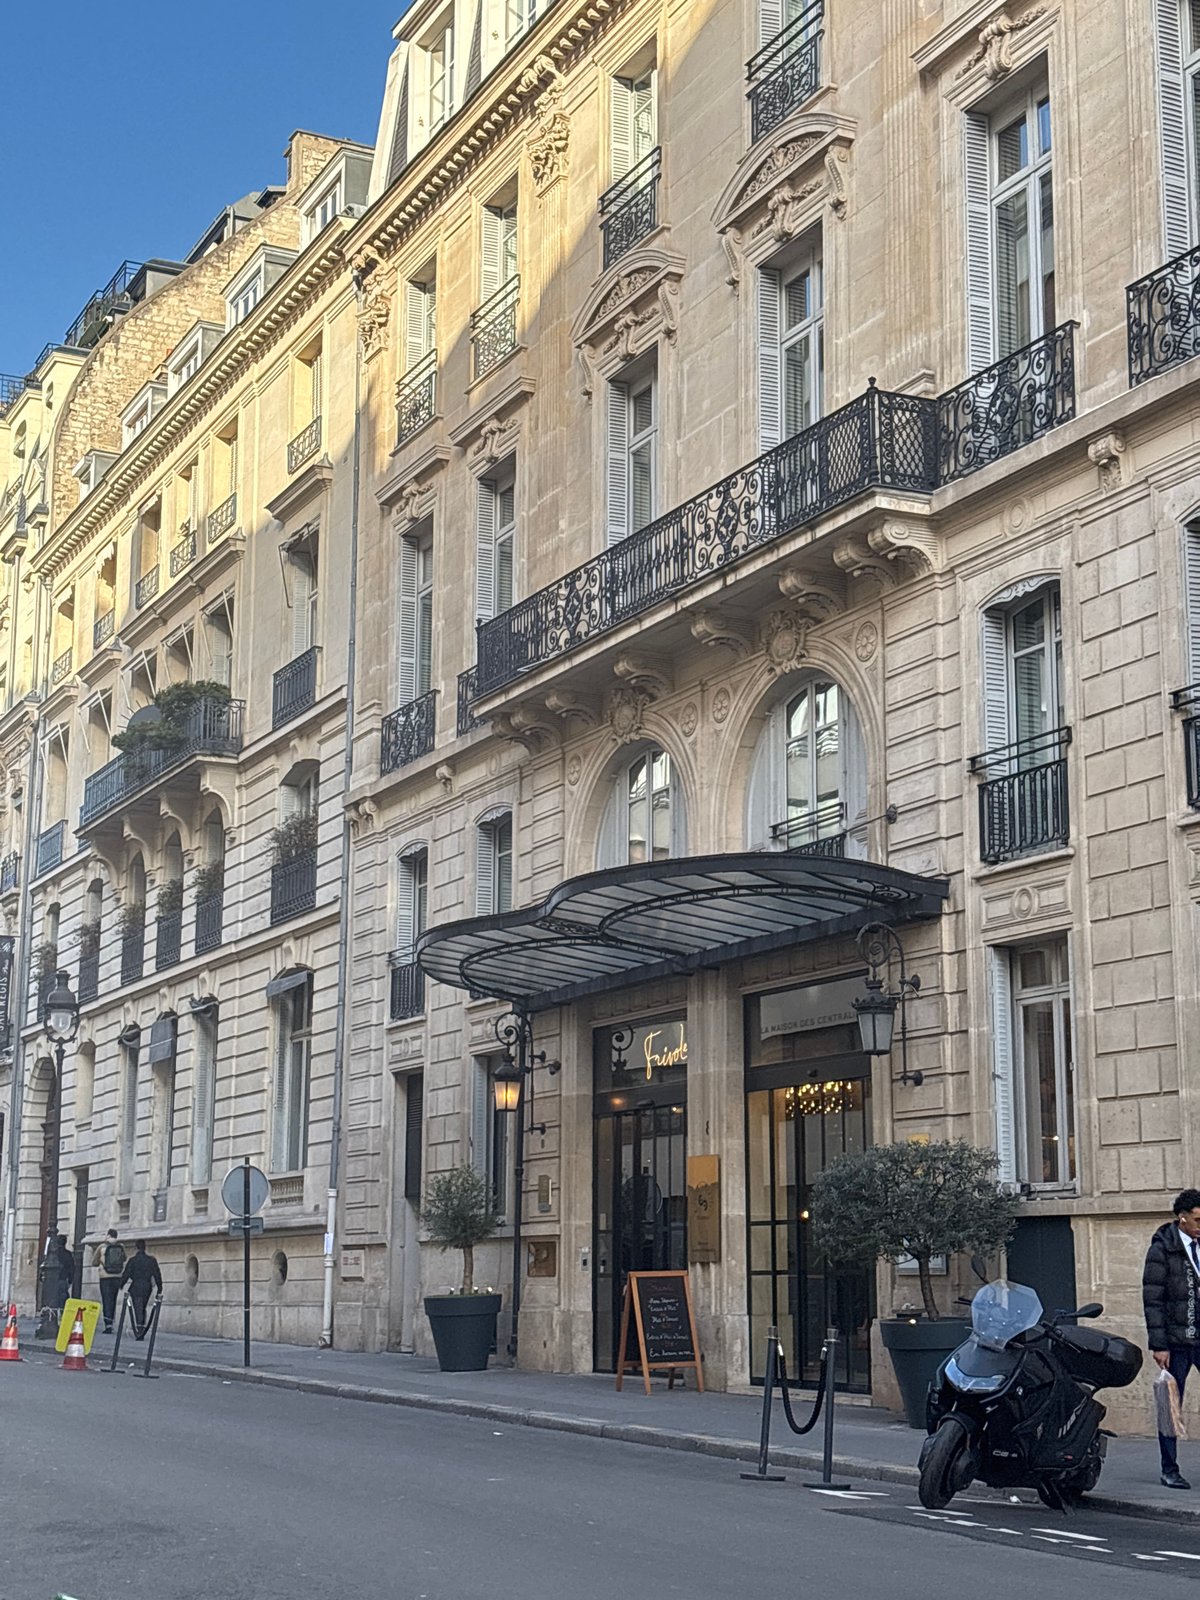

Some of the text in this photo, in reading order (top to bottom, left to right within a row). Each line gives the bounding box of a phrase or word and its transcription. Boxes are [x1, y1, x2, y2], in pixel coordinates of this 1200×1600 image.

[771, 1021, 798, 1032] MAISON
[799, 1017, 816, 1028] DES
[817, 1011, 857, 1025] CENTRALI
